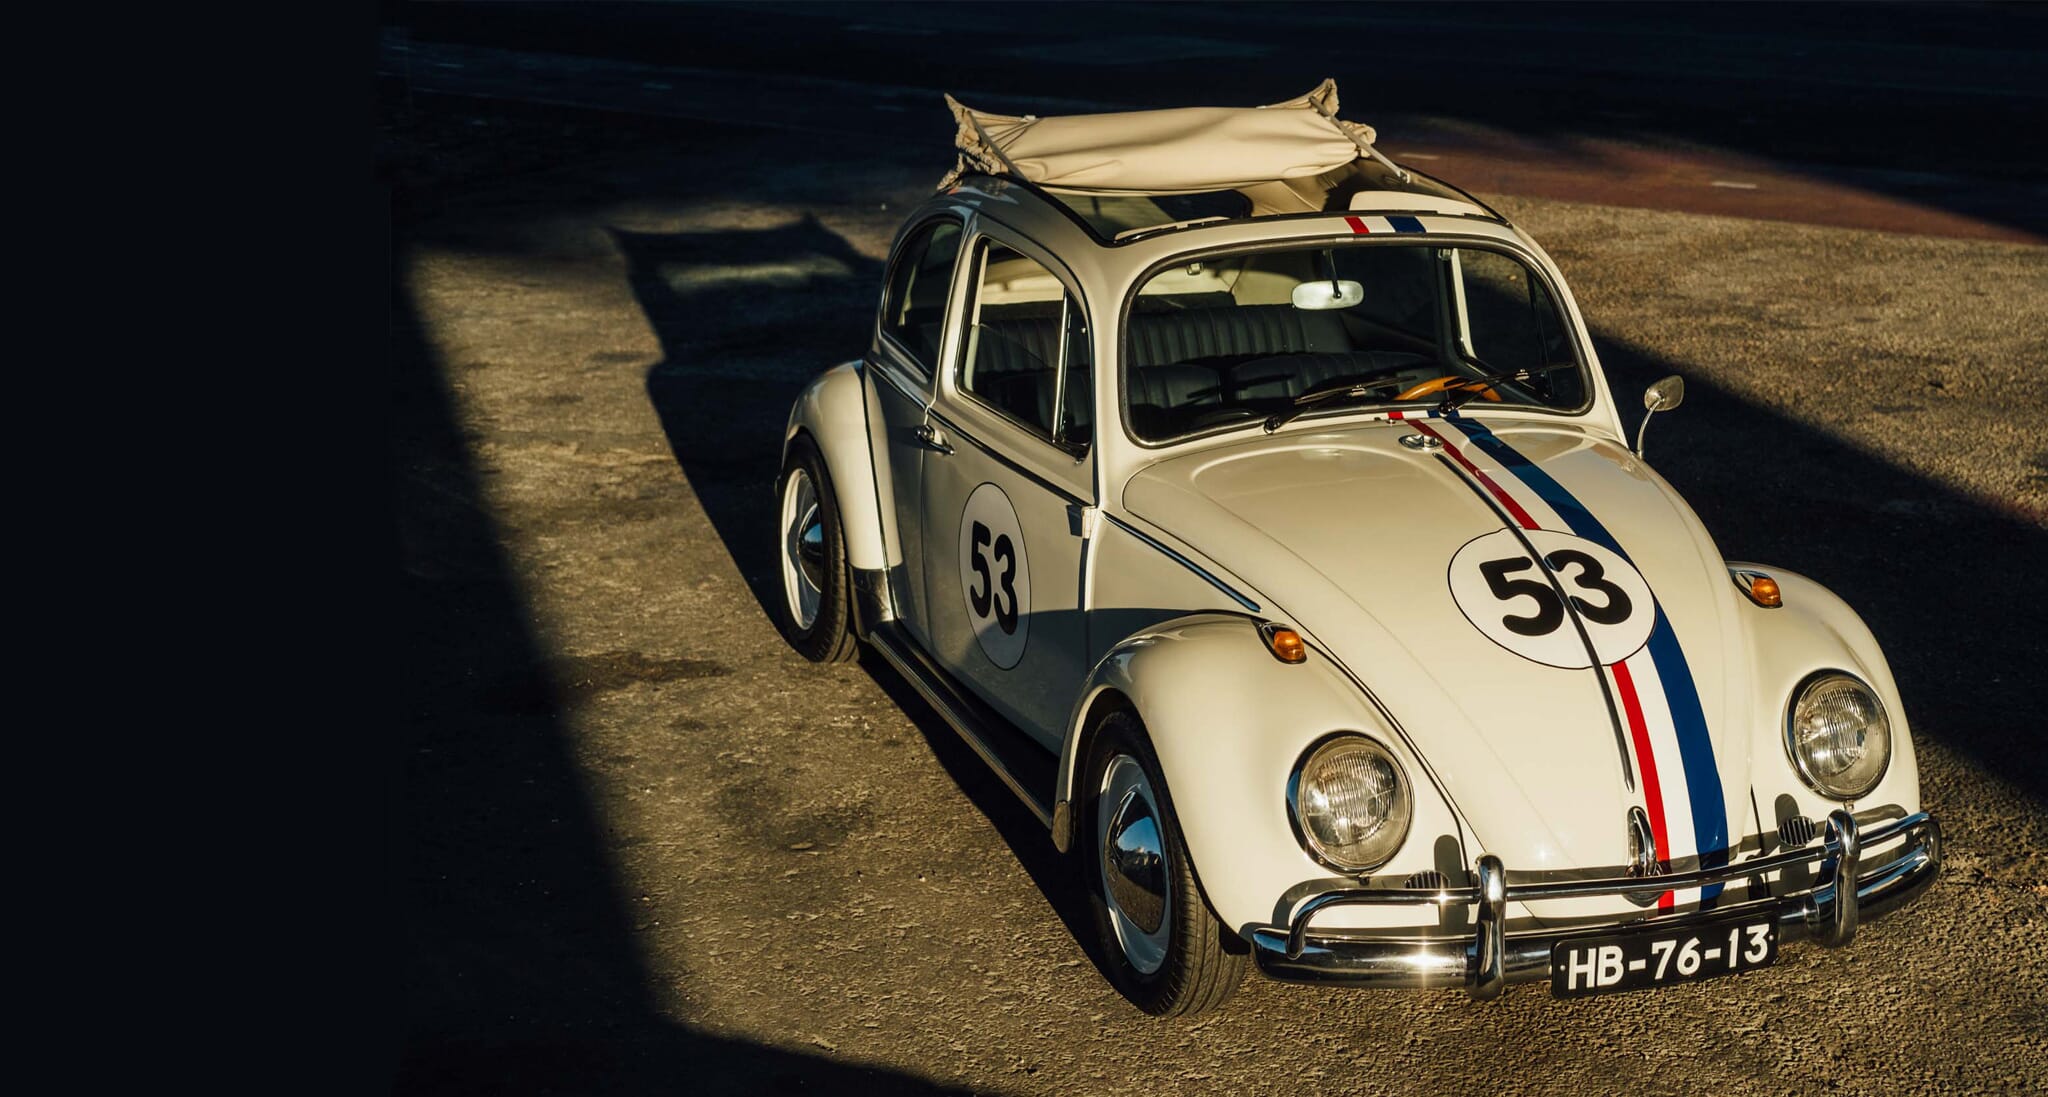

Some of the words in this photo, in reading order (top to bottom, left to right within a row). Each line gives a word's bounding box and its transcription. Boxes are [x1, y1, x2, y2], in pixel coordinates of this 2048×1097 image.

[970, 520, 1018, 635] 53
[1479, 549, 1632, 636] 53
[1568, 924, 1770, 990] HB-76-13
